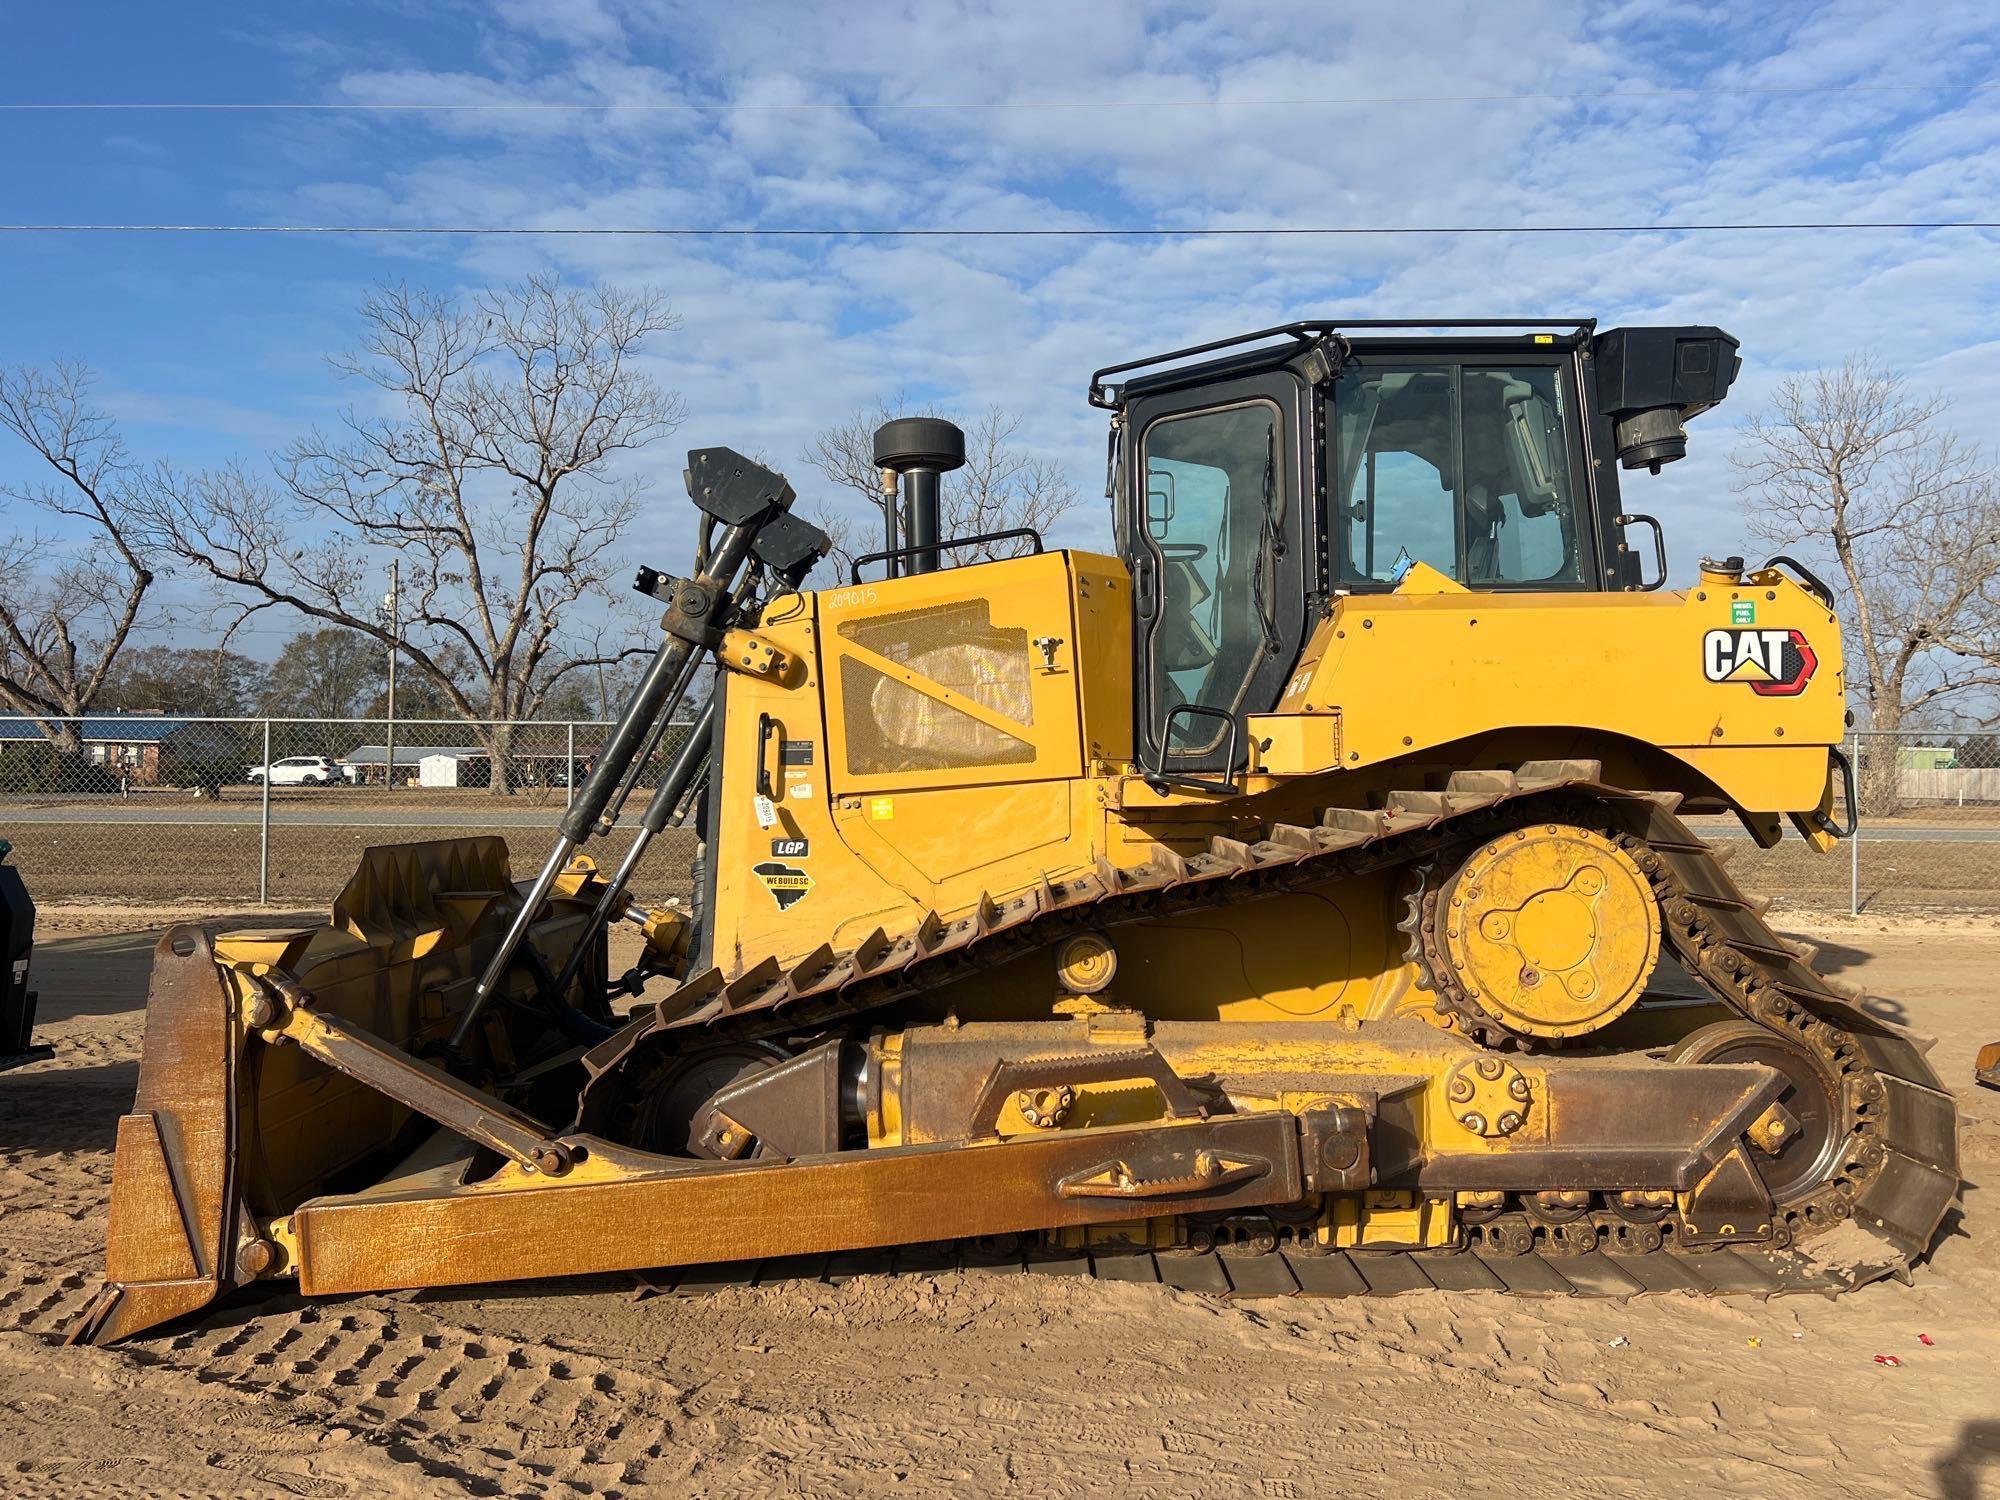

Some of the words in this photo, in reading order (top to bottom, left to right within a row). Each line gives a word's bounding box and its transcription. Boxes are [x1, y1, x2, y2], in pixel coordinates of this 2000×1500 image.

[828, 587, 878, 609] 209015
[1704, 630, 1789, 681] CAT
[777, 841, 804, 854] LGP
[766, 877, 777, 885] WE
[778, 877, 799, 885] BUILD
[799, 877, 809, 885] SC
